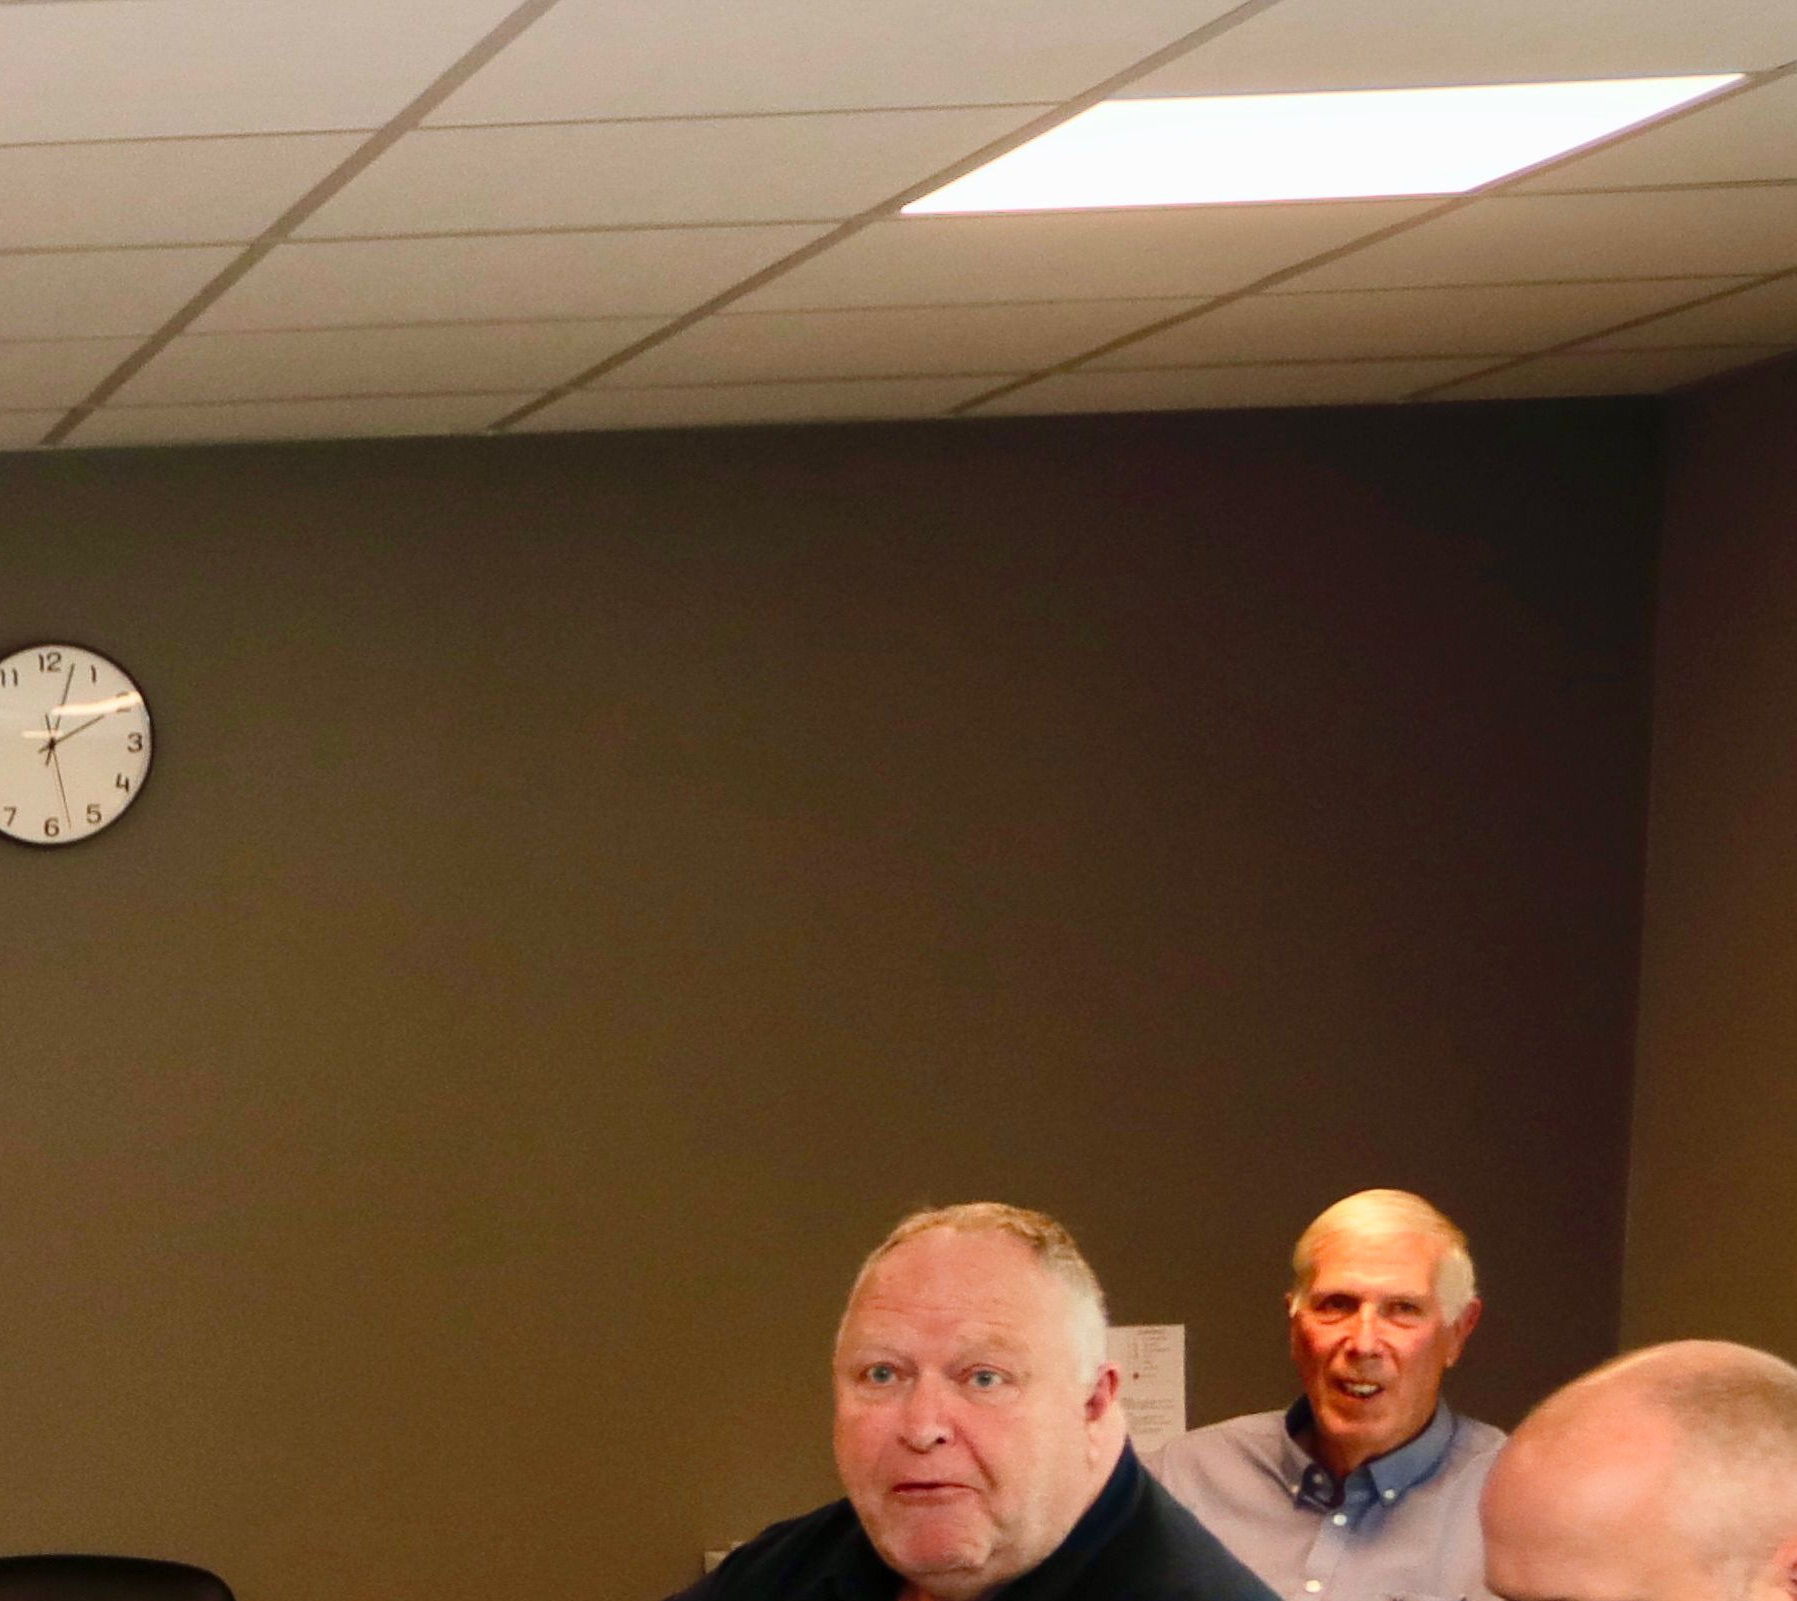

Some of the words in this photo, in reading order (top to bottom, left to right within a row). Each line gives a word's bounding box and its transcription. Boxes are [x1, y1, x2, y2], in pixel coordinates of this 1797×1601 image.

[38, 652, 62, 672] 12
[0, 668, 18, 687] 11
[90, 665, 97, 684] 1
[127, 732, 143, 753] 3
[116, 772, 130, 793] 4
[4, 807, 17, 827] 7
[86, 804, 102, 824] 5
[44, 818, 60, 837] 6
